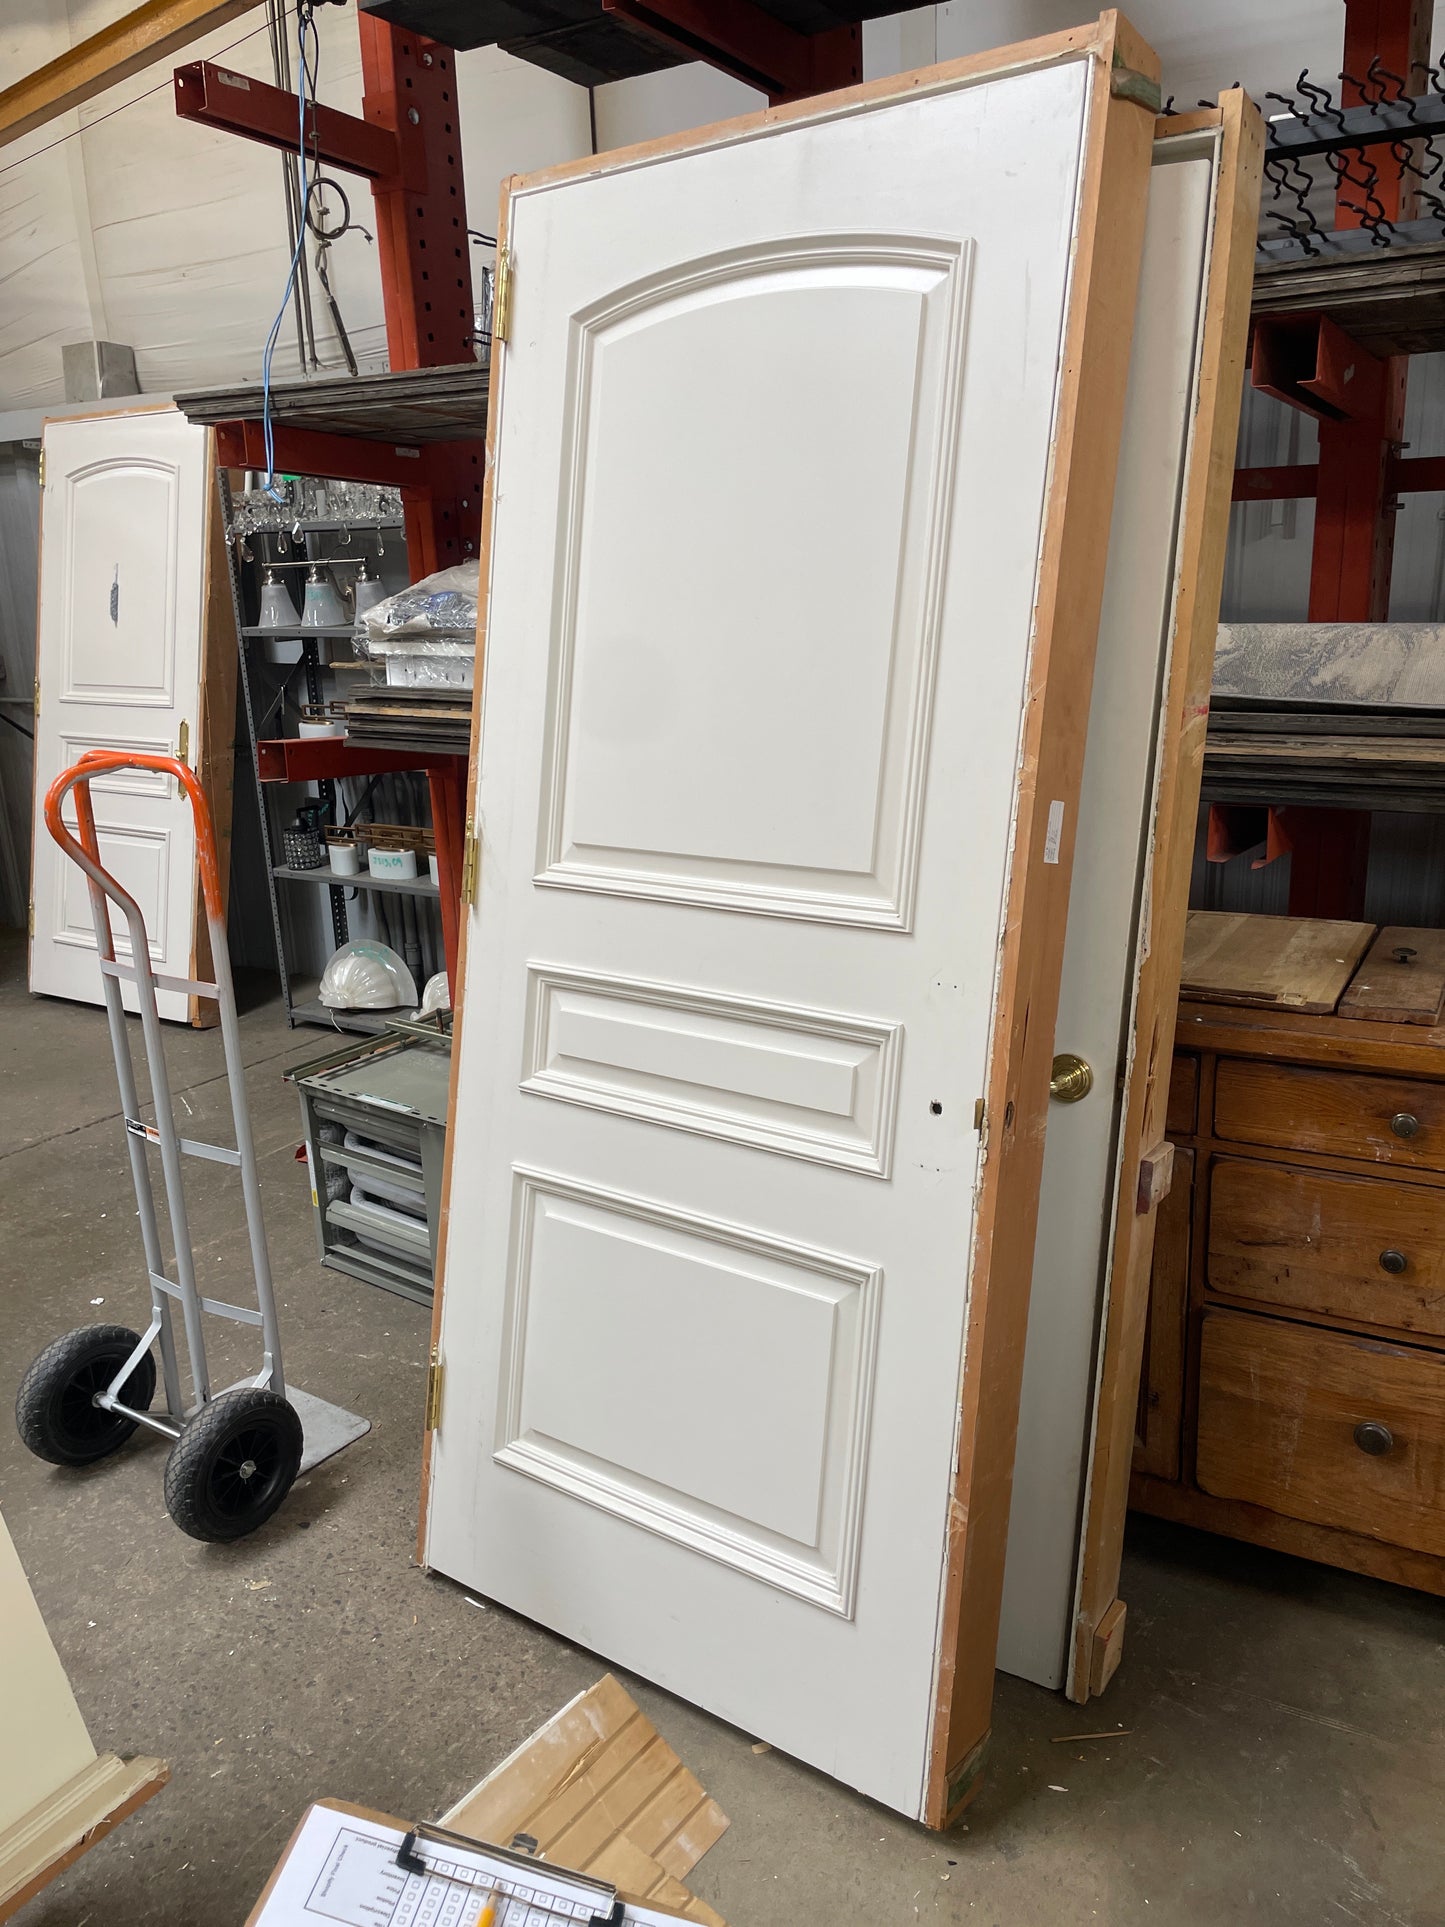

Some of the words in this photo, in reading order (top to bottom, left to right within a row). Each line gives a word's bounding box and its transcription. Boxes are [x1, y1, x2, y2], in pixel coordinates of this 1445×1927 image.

[380, 1869, 405, 1882] Inventory
[386, 1886, 400, 1895] Price
[359, 1904, 391, 1918] Description
